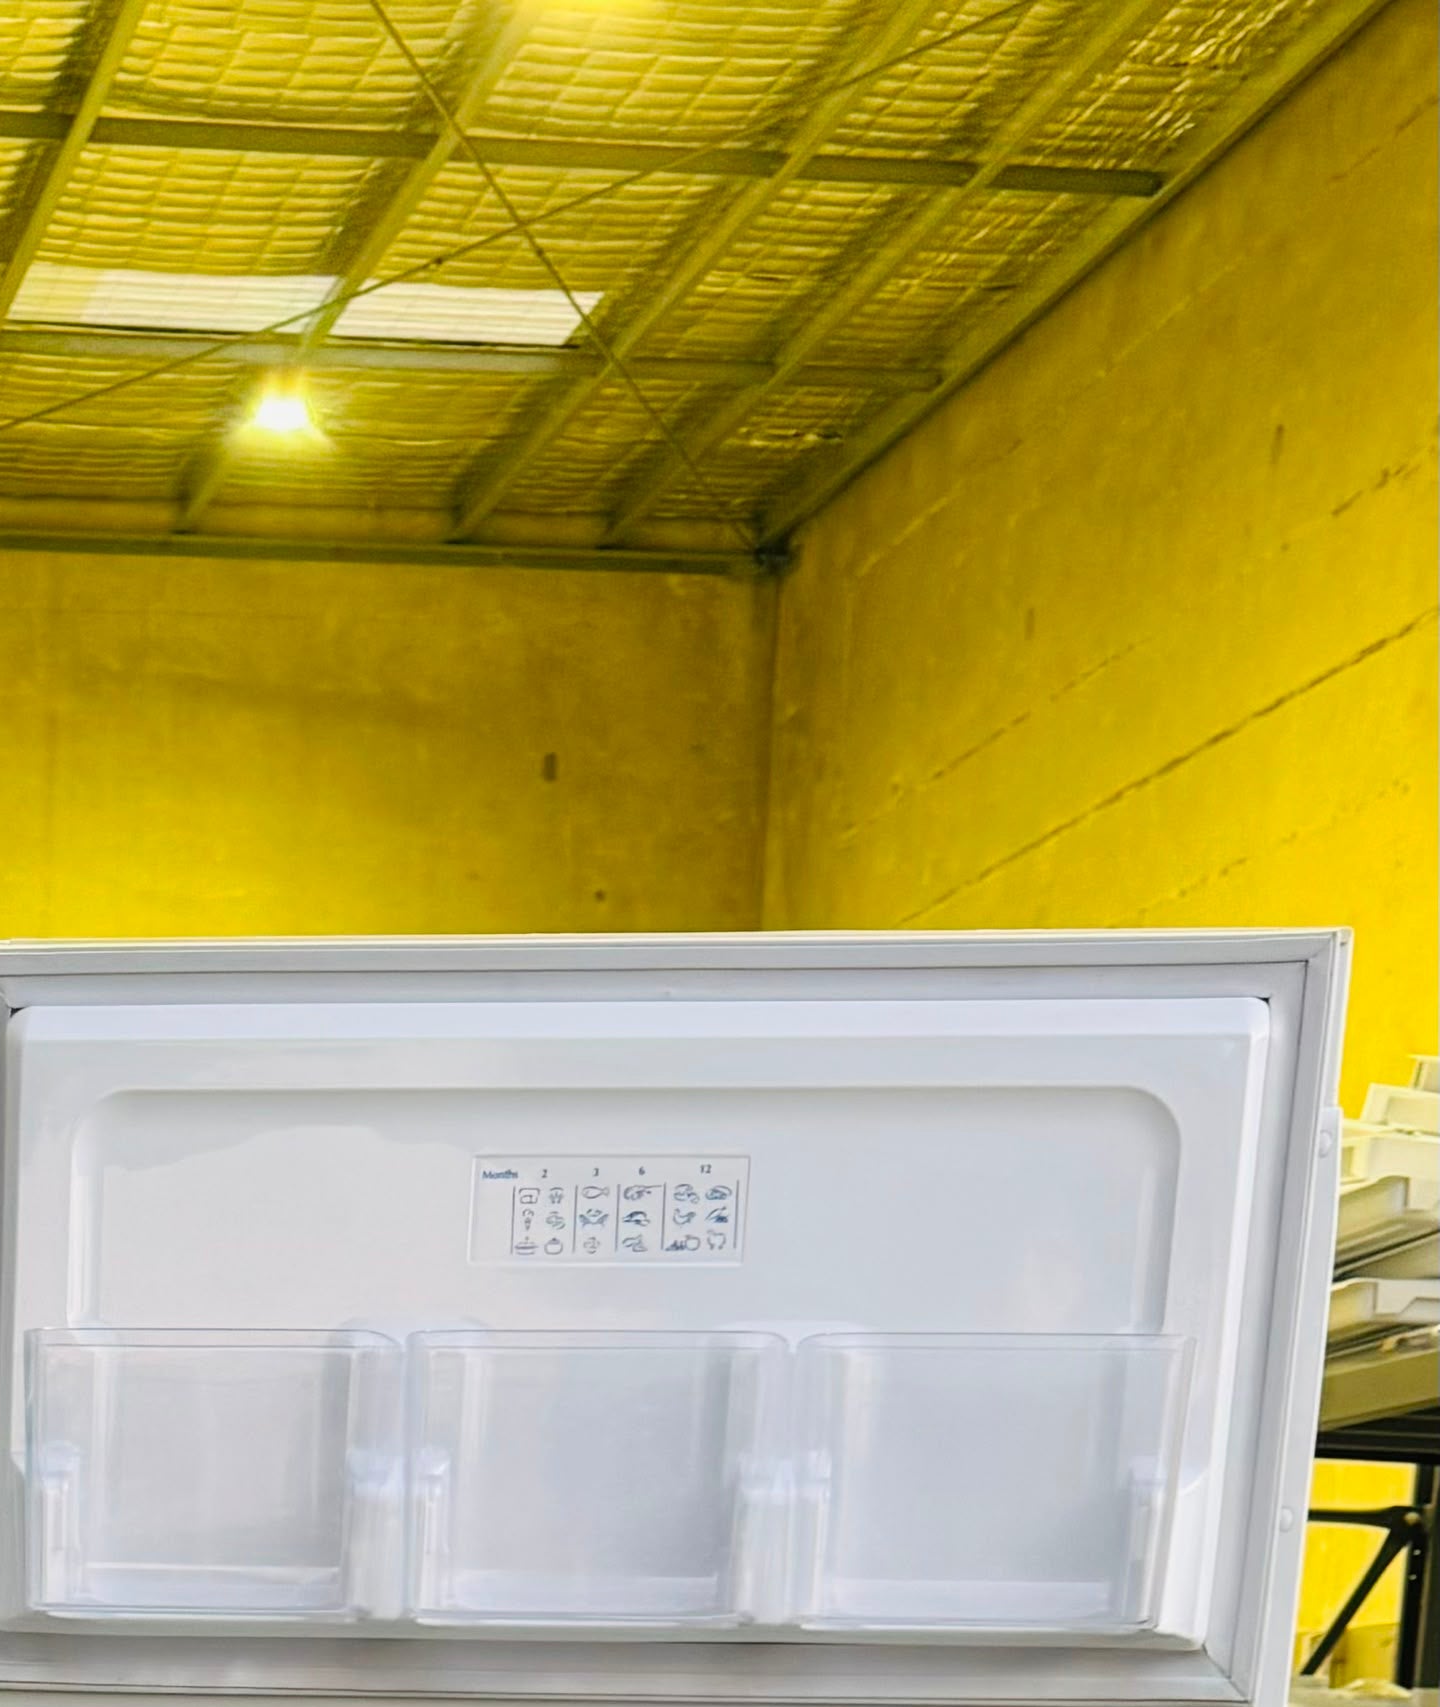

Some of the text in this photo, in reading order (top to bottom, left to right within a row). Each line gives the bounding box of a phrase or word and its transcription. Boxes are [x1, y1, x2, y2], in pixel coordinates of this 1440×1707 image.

[482, 1168, 519, 1180] Months
[541, 1168, 548, 1179] 2
[638, 1166, 646, 1176] 6
[700, 1164, 712, 1174] 12
